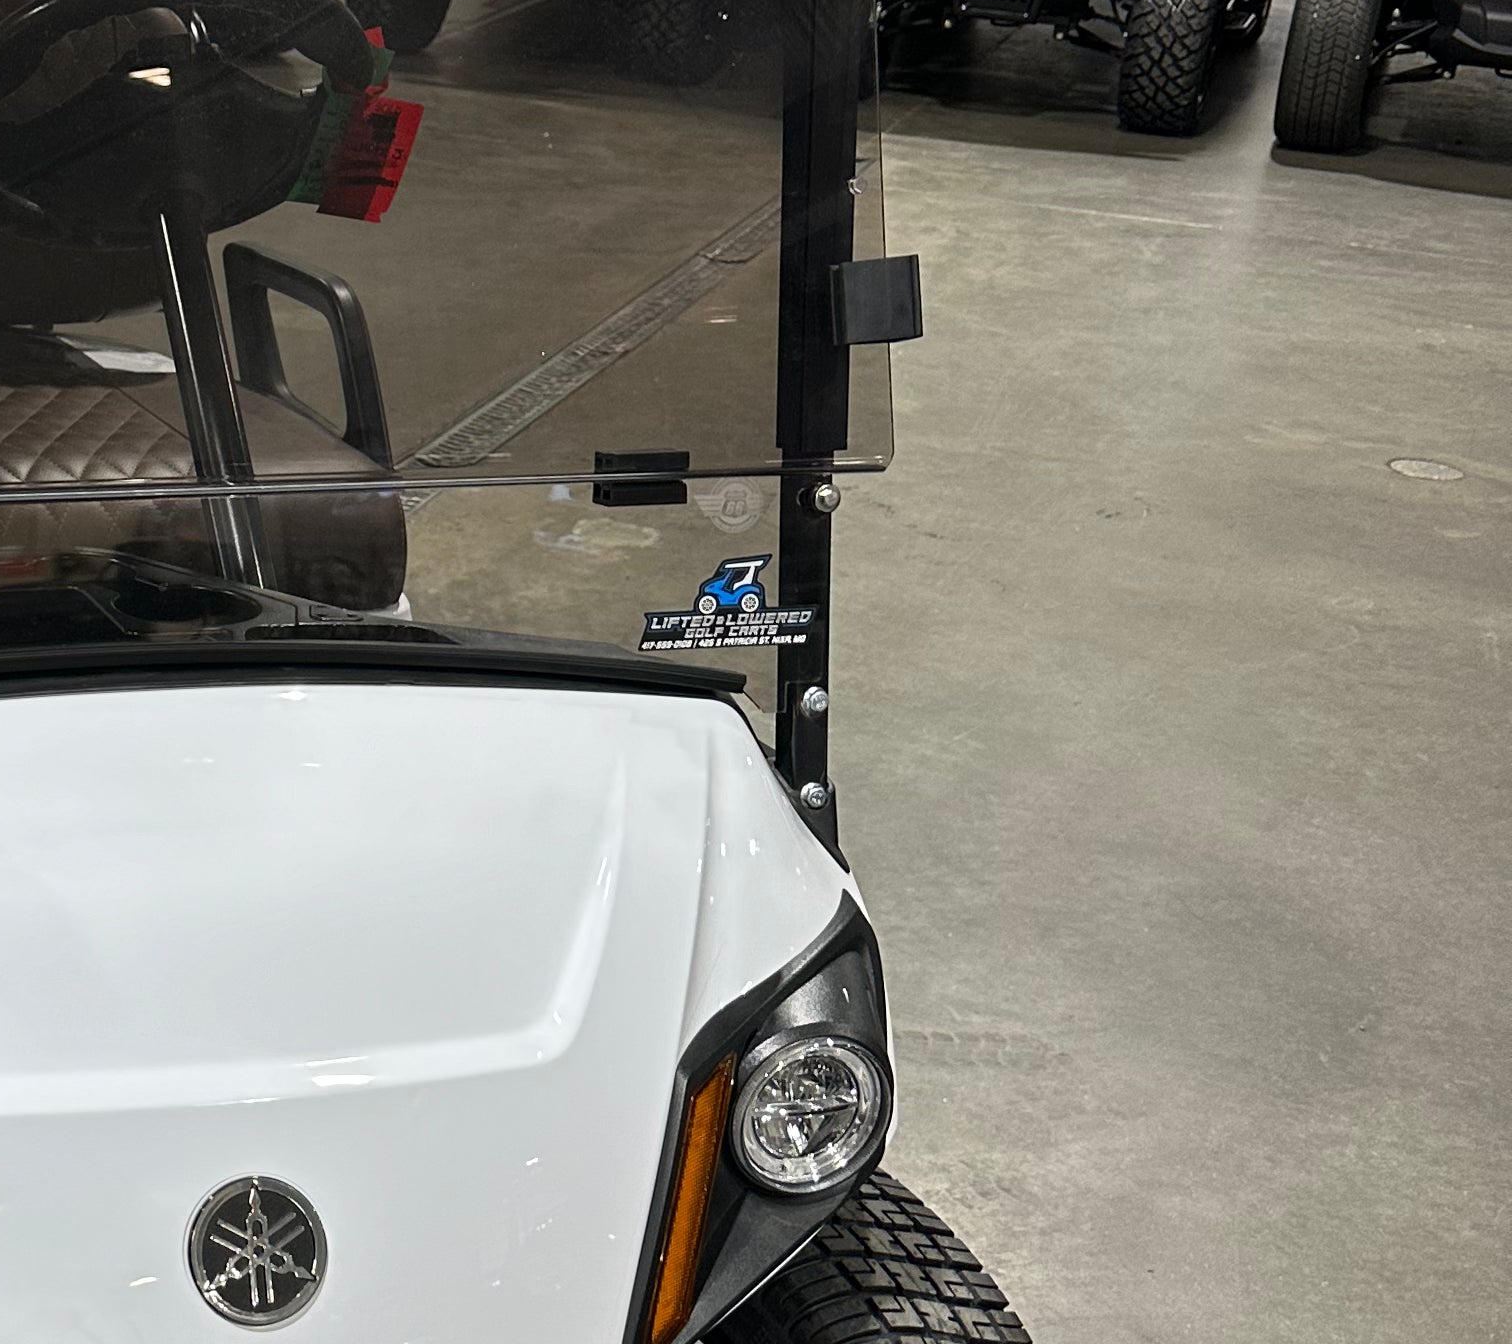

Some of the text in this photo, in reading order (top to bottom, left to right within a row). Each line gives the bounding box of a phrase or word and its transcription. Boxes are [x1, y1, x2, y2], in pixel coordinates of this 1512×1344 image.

[650, 614, 716, 630] LIFTED
[725, 610, 812, 626] LOWERED
[684, 624, 778, 639] GOLF CARTS
